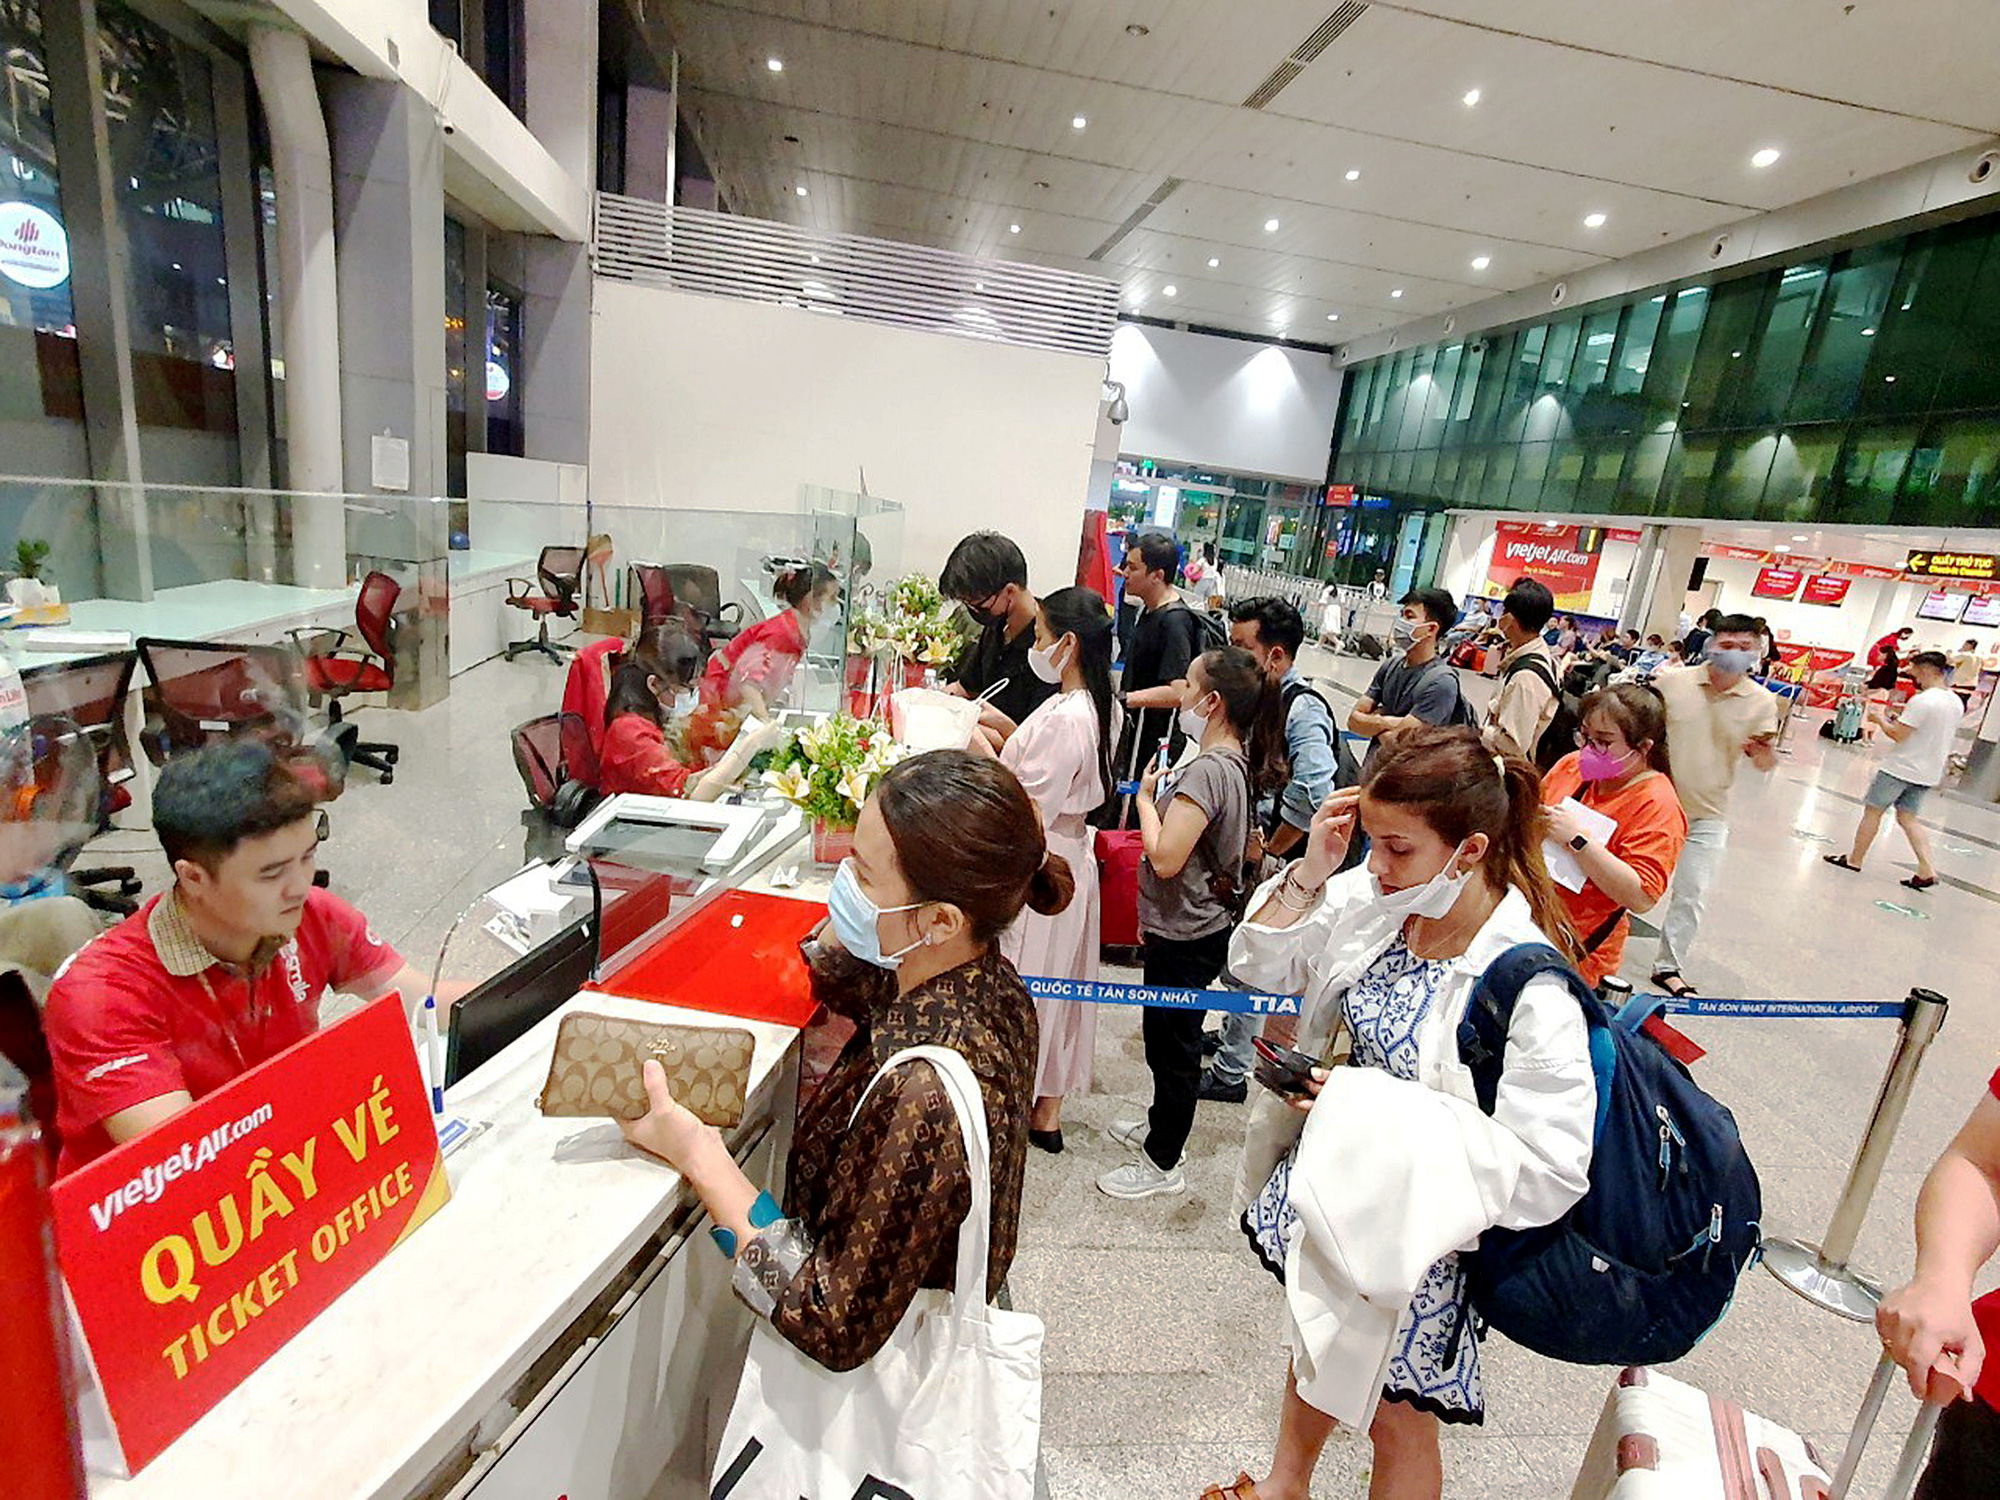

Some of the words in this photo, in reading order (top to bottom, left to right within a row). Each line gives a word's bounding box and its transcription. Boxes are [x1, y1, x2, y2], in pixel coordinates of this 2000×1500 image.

[1030, 979, 1071, 995] QUỐC
[1077, 980, 1092, 997] TẾ
[1097, 984, 1124, 1000] TÂN
[1128, 986, 1158, 1002] SƠN
[1161, 988, 1199, 1005] NHẤT
[1249, 995, 1303, 1014] TIA
[1698, 1002, 1718, 1012] TAN
[1718, 1003, 1740, 1013] SON
[1740, 1003, 1766, 1013] NHAT
[1766, 1003, 1837, 1014] INTERNATIONAL
[1838, 1004, 1880, 1014] AIRPORT
[141, 1147, 318, 1304] QUẦY
[331, 1074, 400, 1163] VÉ
[162, 1248, 299, 1380] TICKET
[312, 1162, 414, 1263] OFFICE
